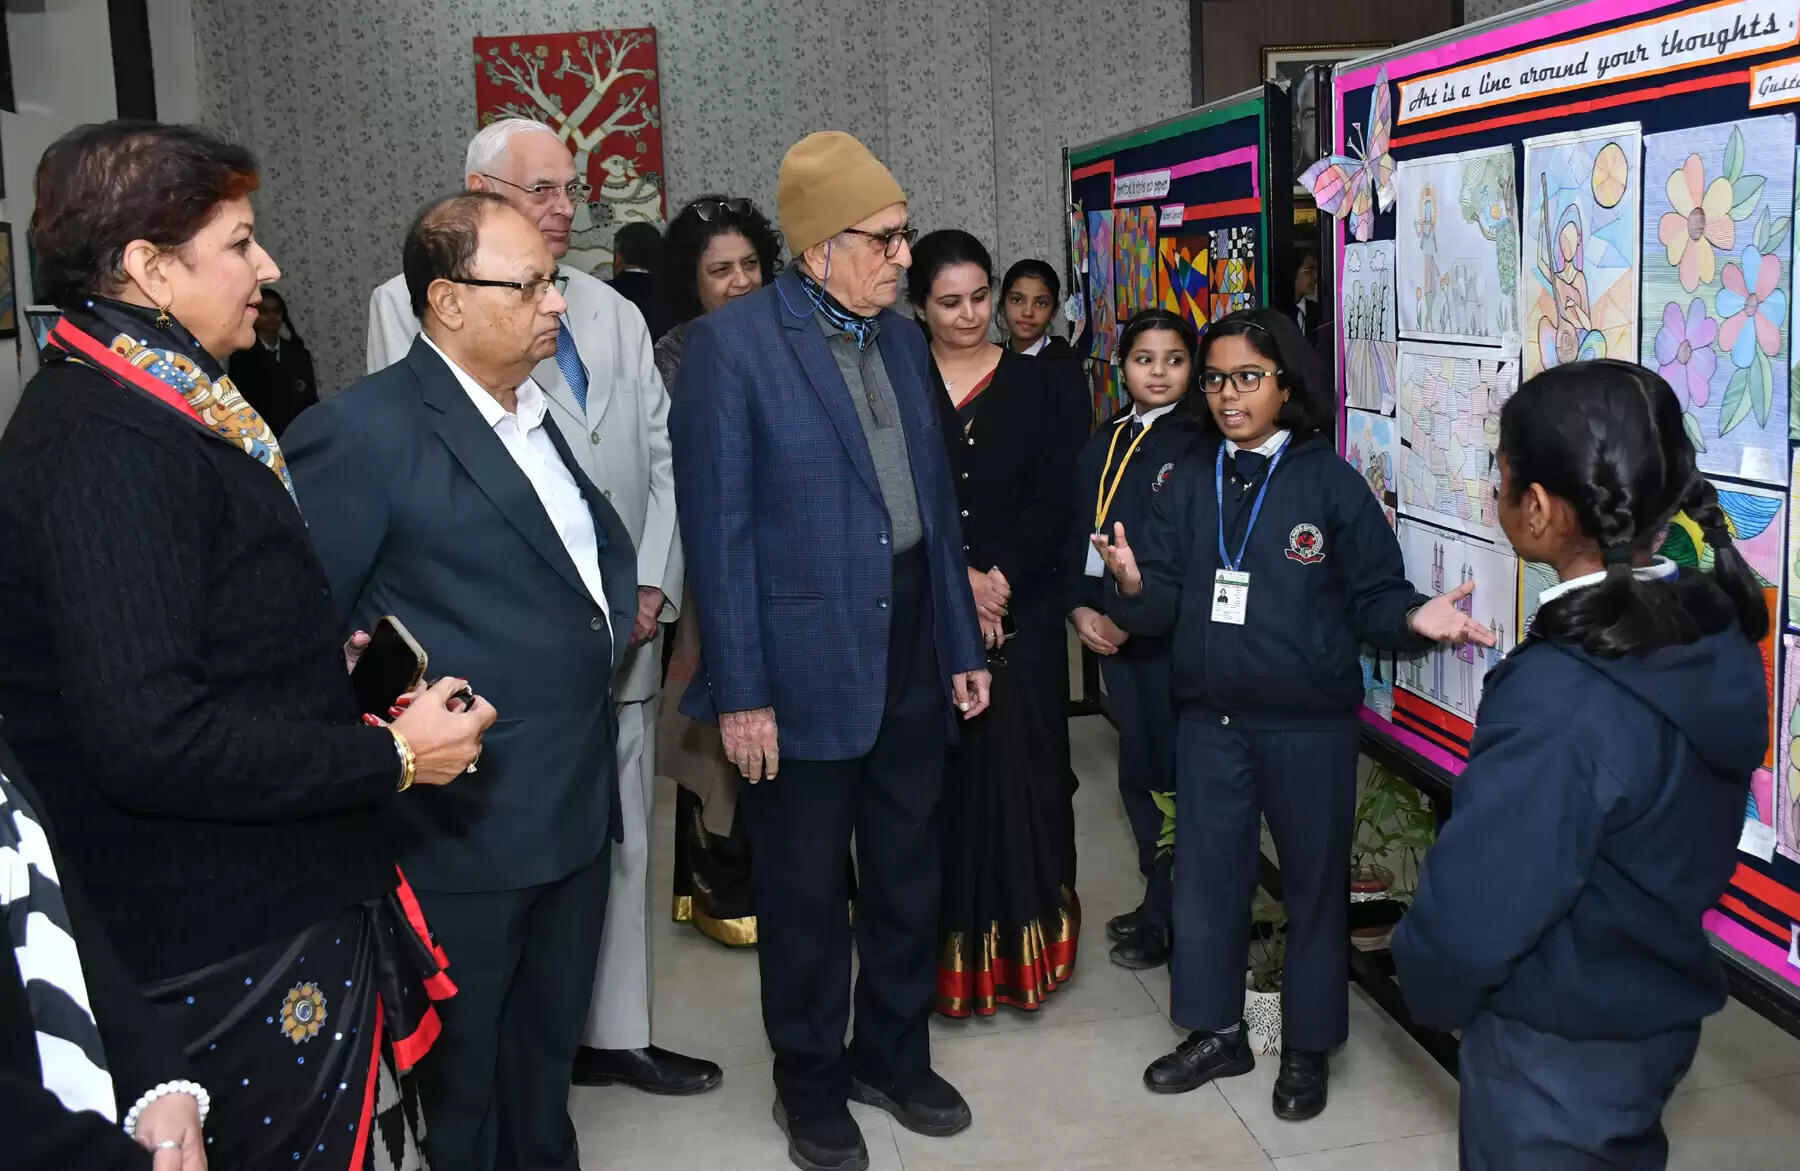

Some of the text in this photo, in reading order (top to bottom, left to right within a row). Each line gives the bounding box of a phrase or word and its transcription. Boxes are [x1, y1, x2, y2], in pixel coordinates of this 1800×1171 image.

[1409, 86, 1437, 112] Art
[1443, 82, 1456, 102] is
[1461, 85, 1472, 99] a
[1519, 51, 1589, 84] around
[1597, 44, 1649, 79] your
